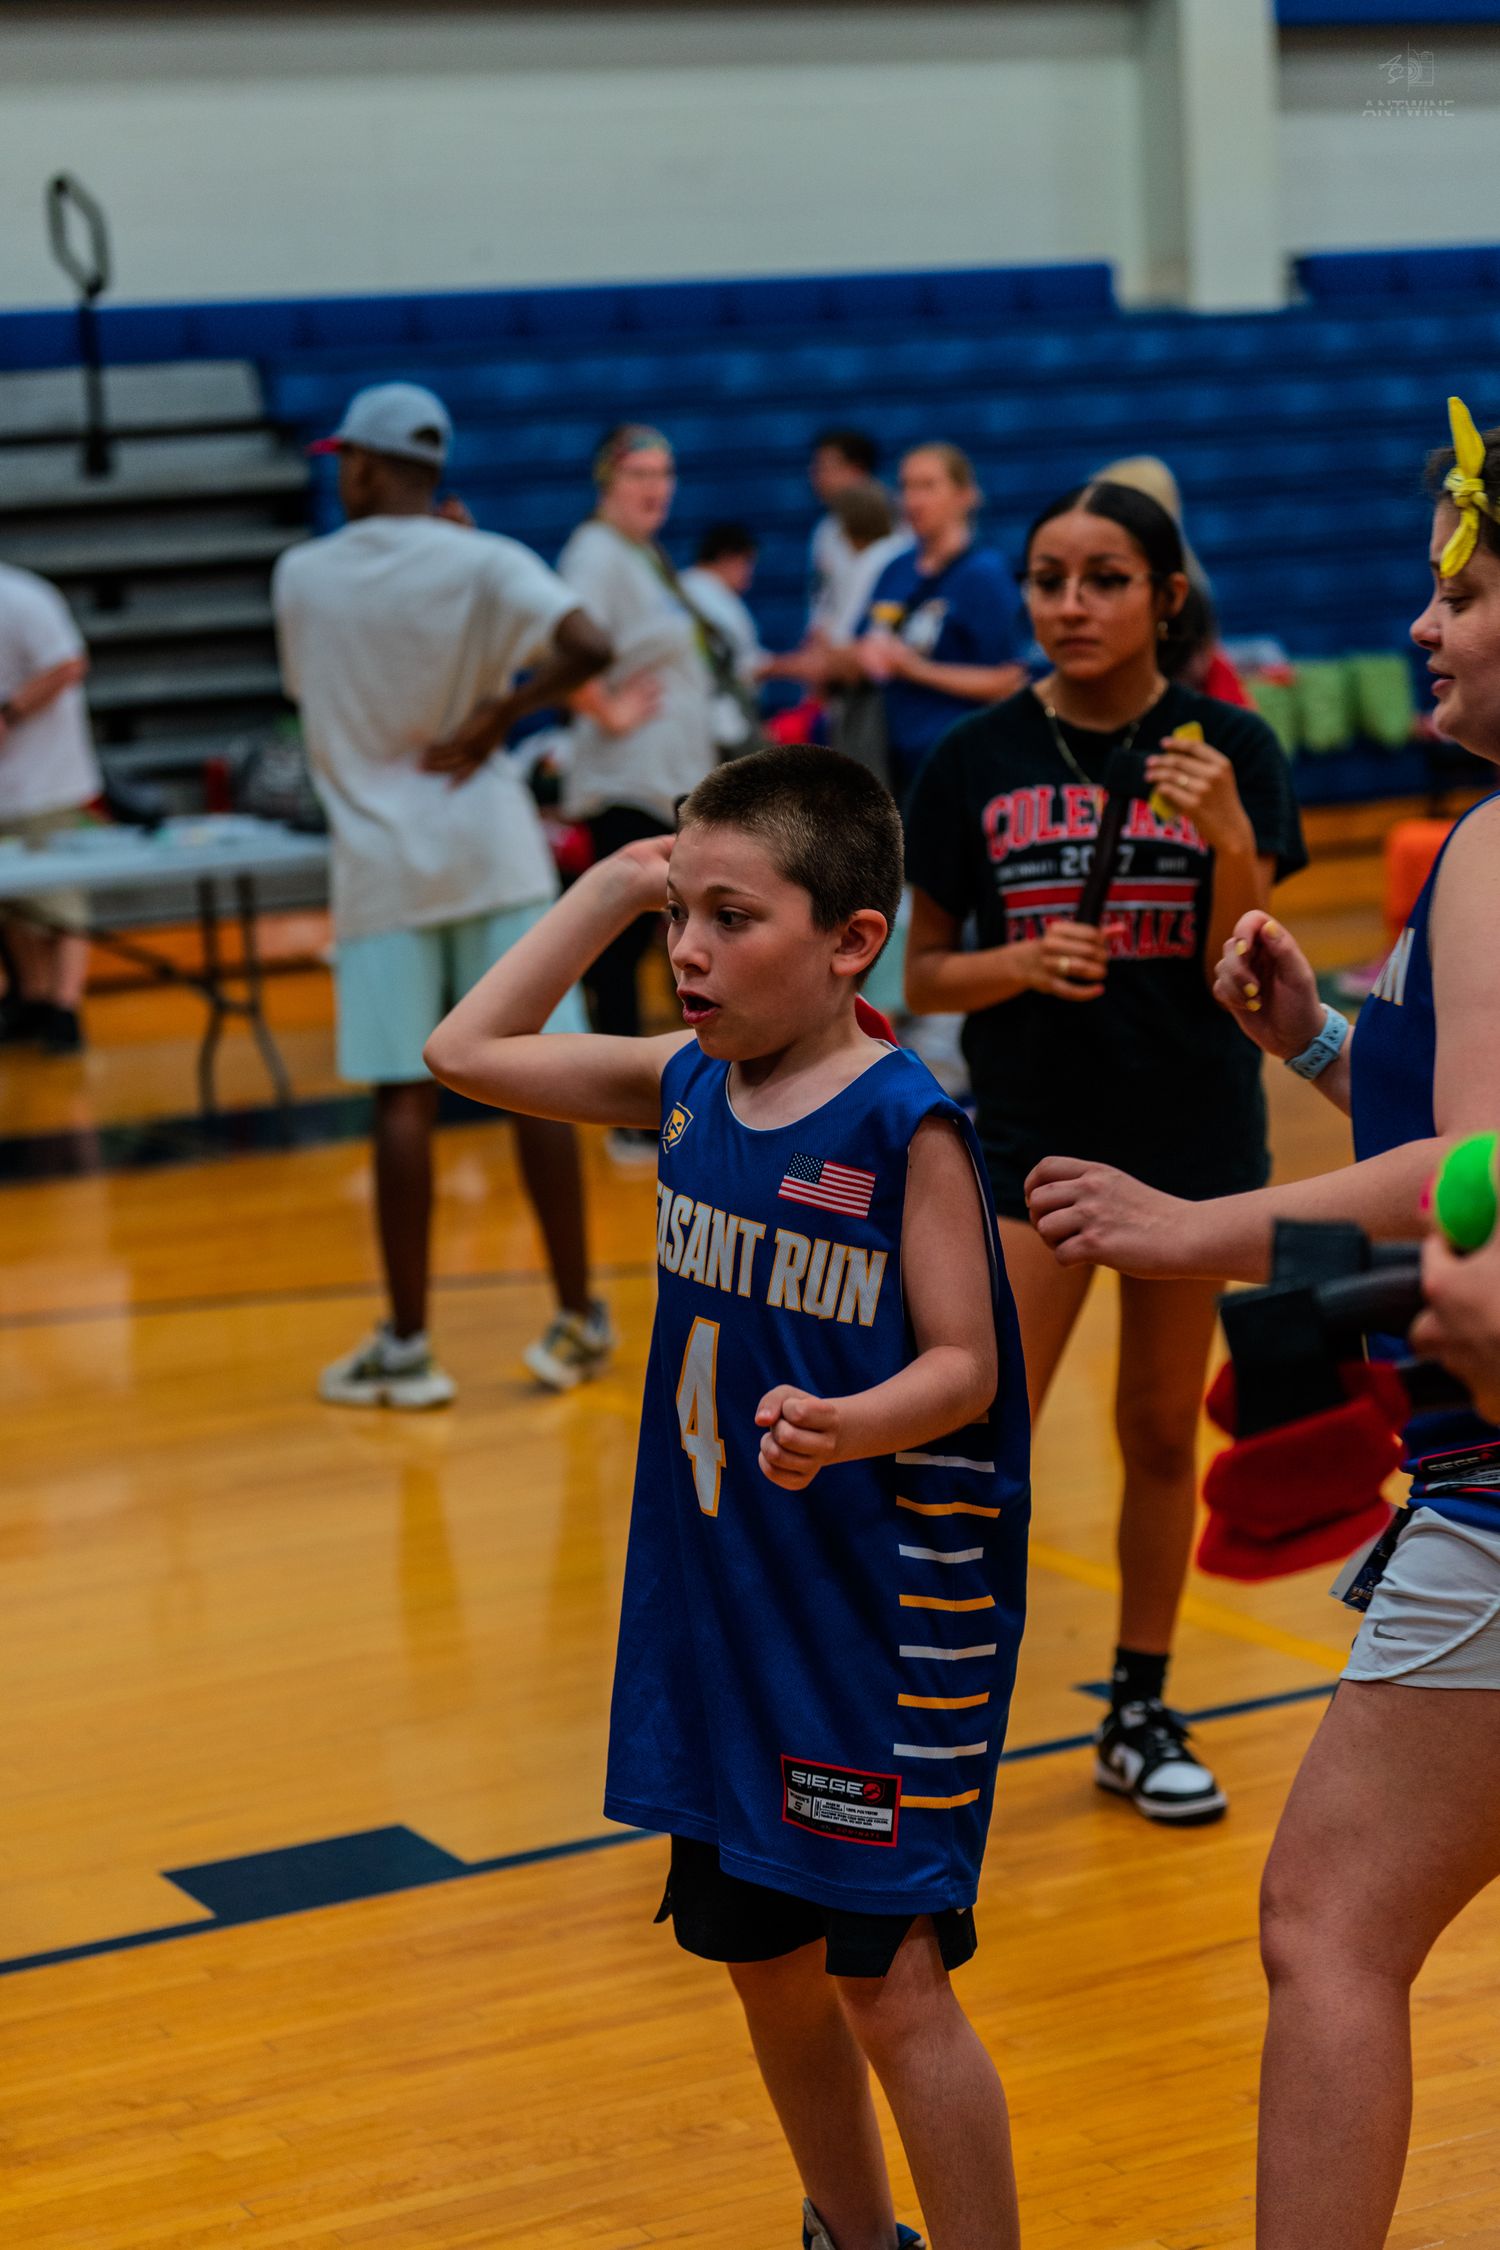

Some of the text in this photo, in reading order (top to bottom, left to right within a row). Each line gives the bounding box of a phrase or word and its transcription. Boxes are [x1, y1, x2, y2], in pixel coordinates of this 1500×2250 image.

[1060, 844, 1137, 877] 207
[766, 1228, 888, 1327] RUN
[676, 1316, 727, 1518] 4
[791, 1770, 864, 1796] SIEGE
